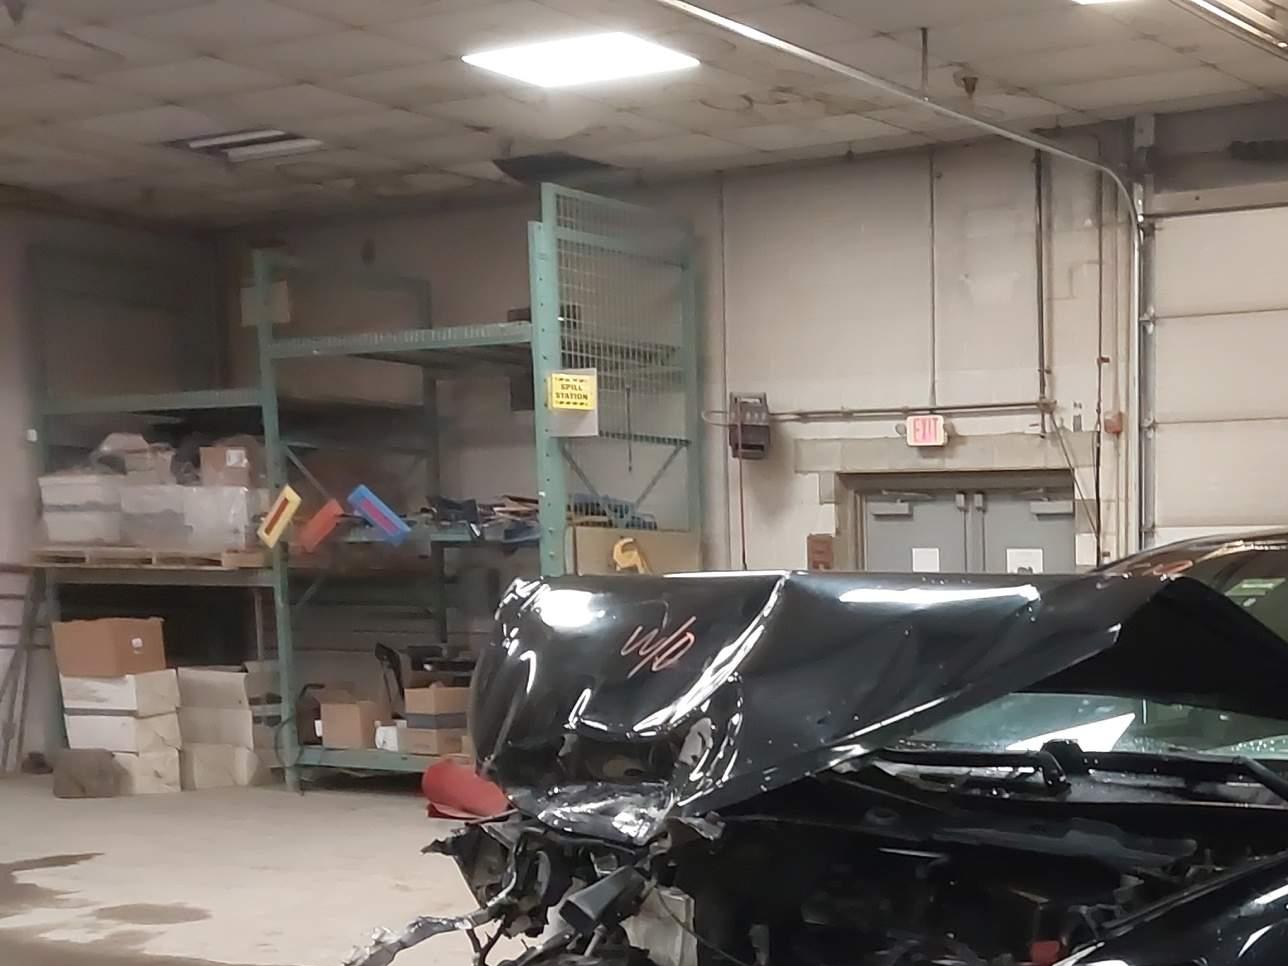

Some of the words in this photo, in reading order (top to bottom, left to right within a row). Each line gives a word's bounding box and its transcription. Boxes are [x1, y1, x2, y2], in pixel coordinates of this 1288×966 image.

[560, 383, 583, 391] SPILL
[555, 392, 588, 400] STATION
[913, 417, 939, 442] EXIT
